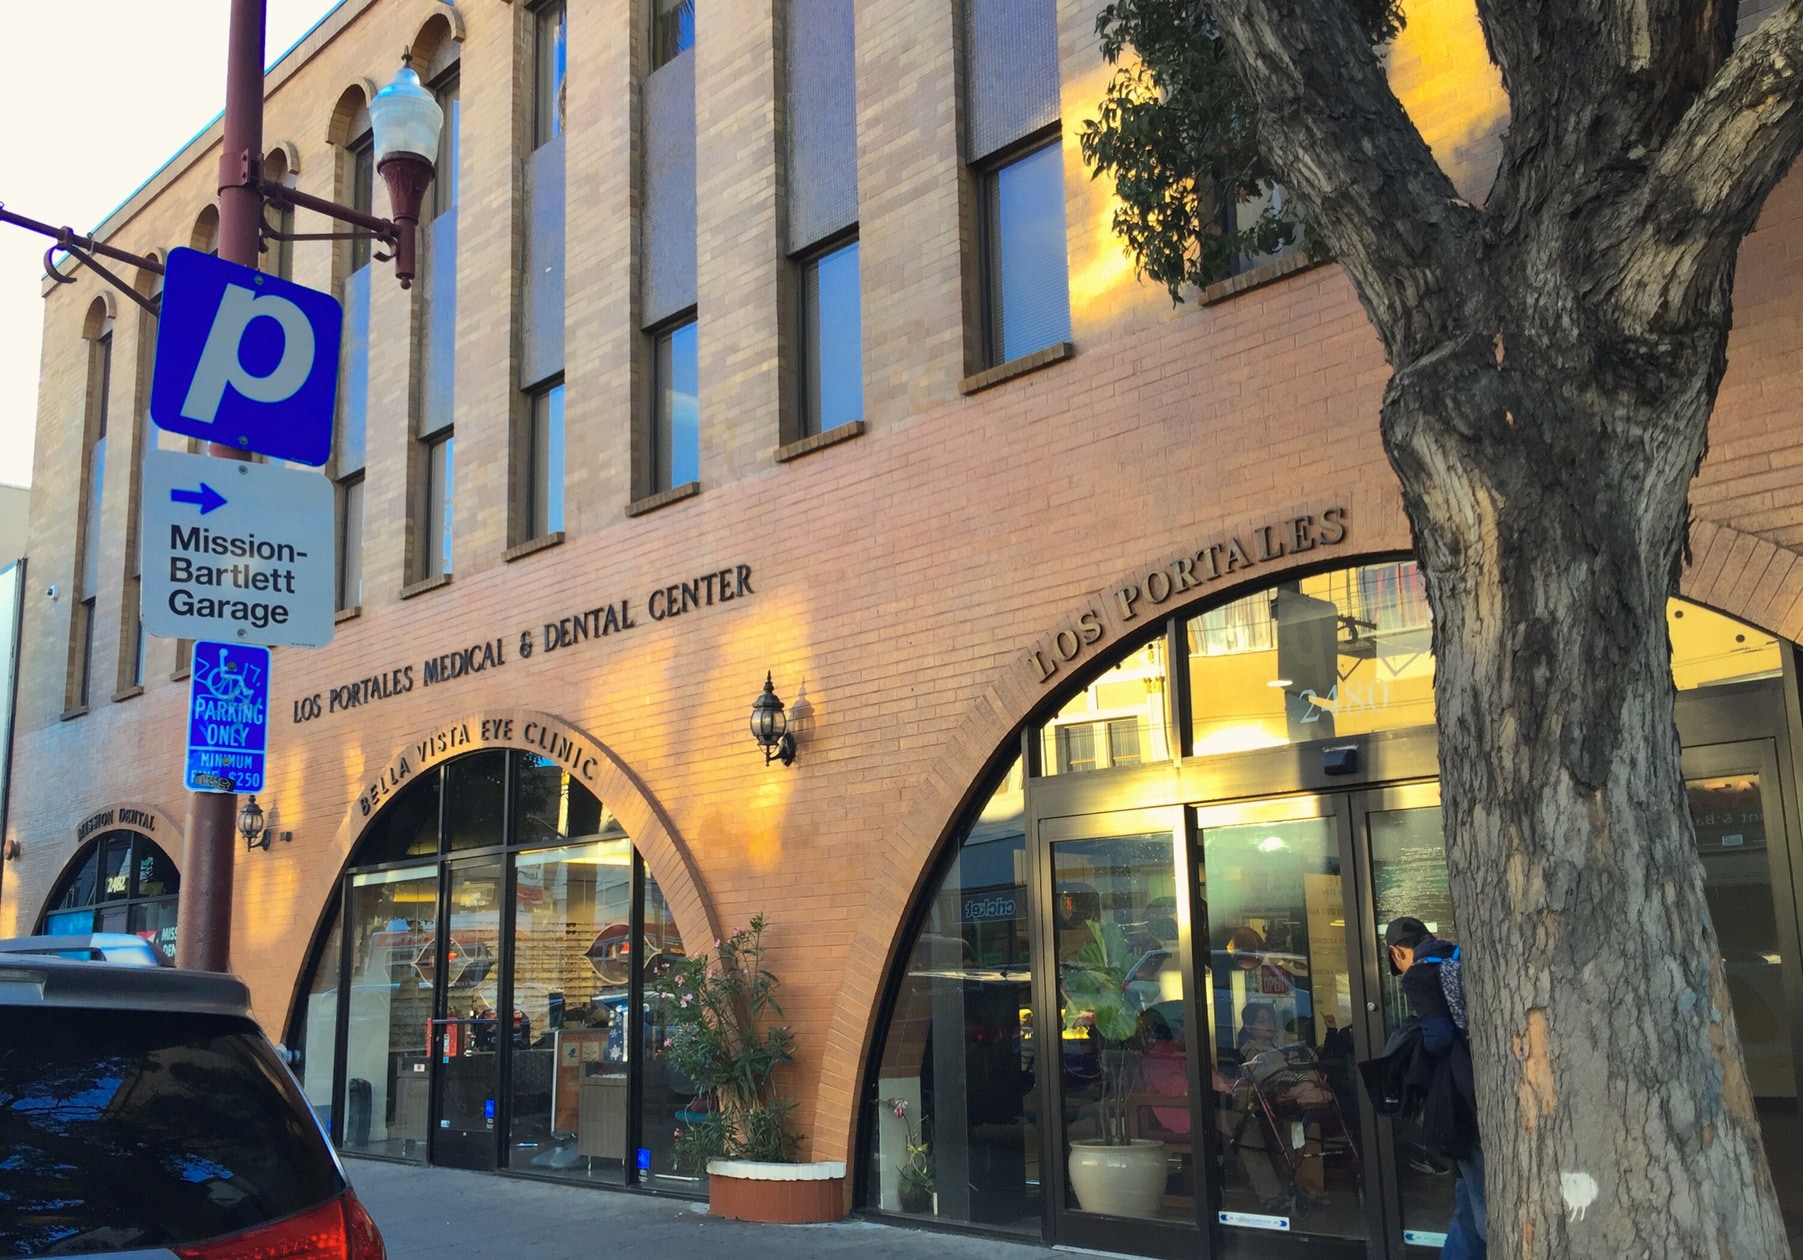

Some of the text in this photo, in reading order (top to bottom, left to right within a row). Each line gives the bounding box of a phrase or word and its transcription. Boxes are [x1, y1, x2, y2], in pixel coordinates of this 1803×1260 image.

[170, 524, 308, 563] Mission-
[170, 556, 296, 594] Bartlett
[168, 589, 289, 628] Garage
[1026, 506, 1348, 685] LOS PORTALES
[293, 563, 756, 723] LOS PORTALES MEDICAL & DENTAL CENTER
[194, 699, 264, 726] PARKING
[1298, 678, 1390, 724] 2480
[206, 723, 250, 748] ONLY
[228, 771, 261, 788] $250
[359, 718, 599, 817] BELLA VISTA EYE CLINIC
[77, 808, 156, 842] MISSION DENTAL
